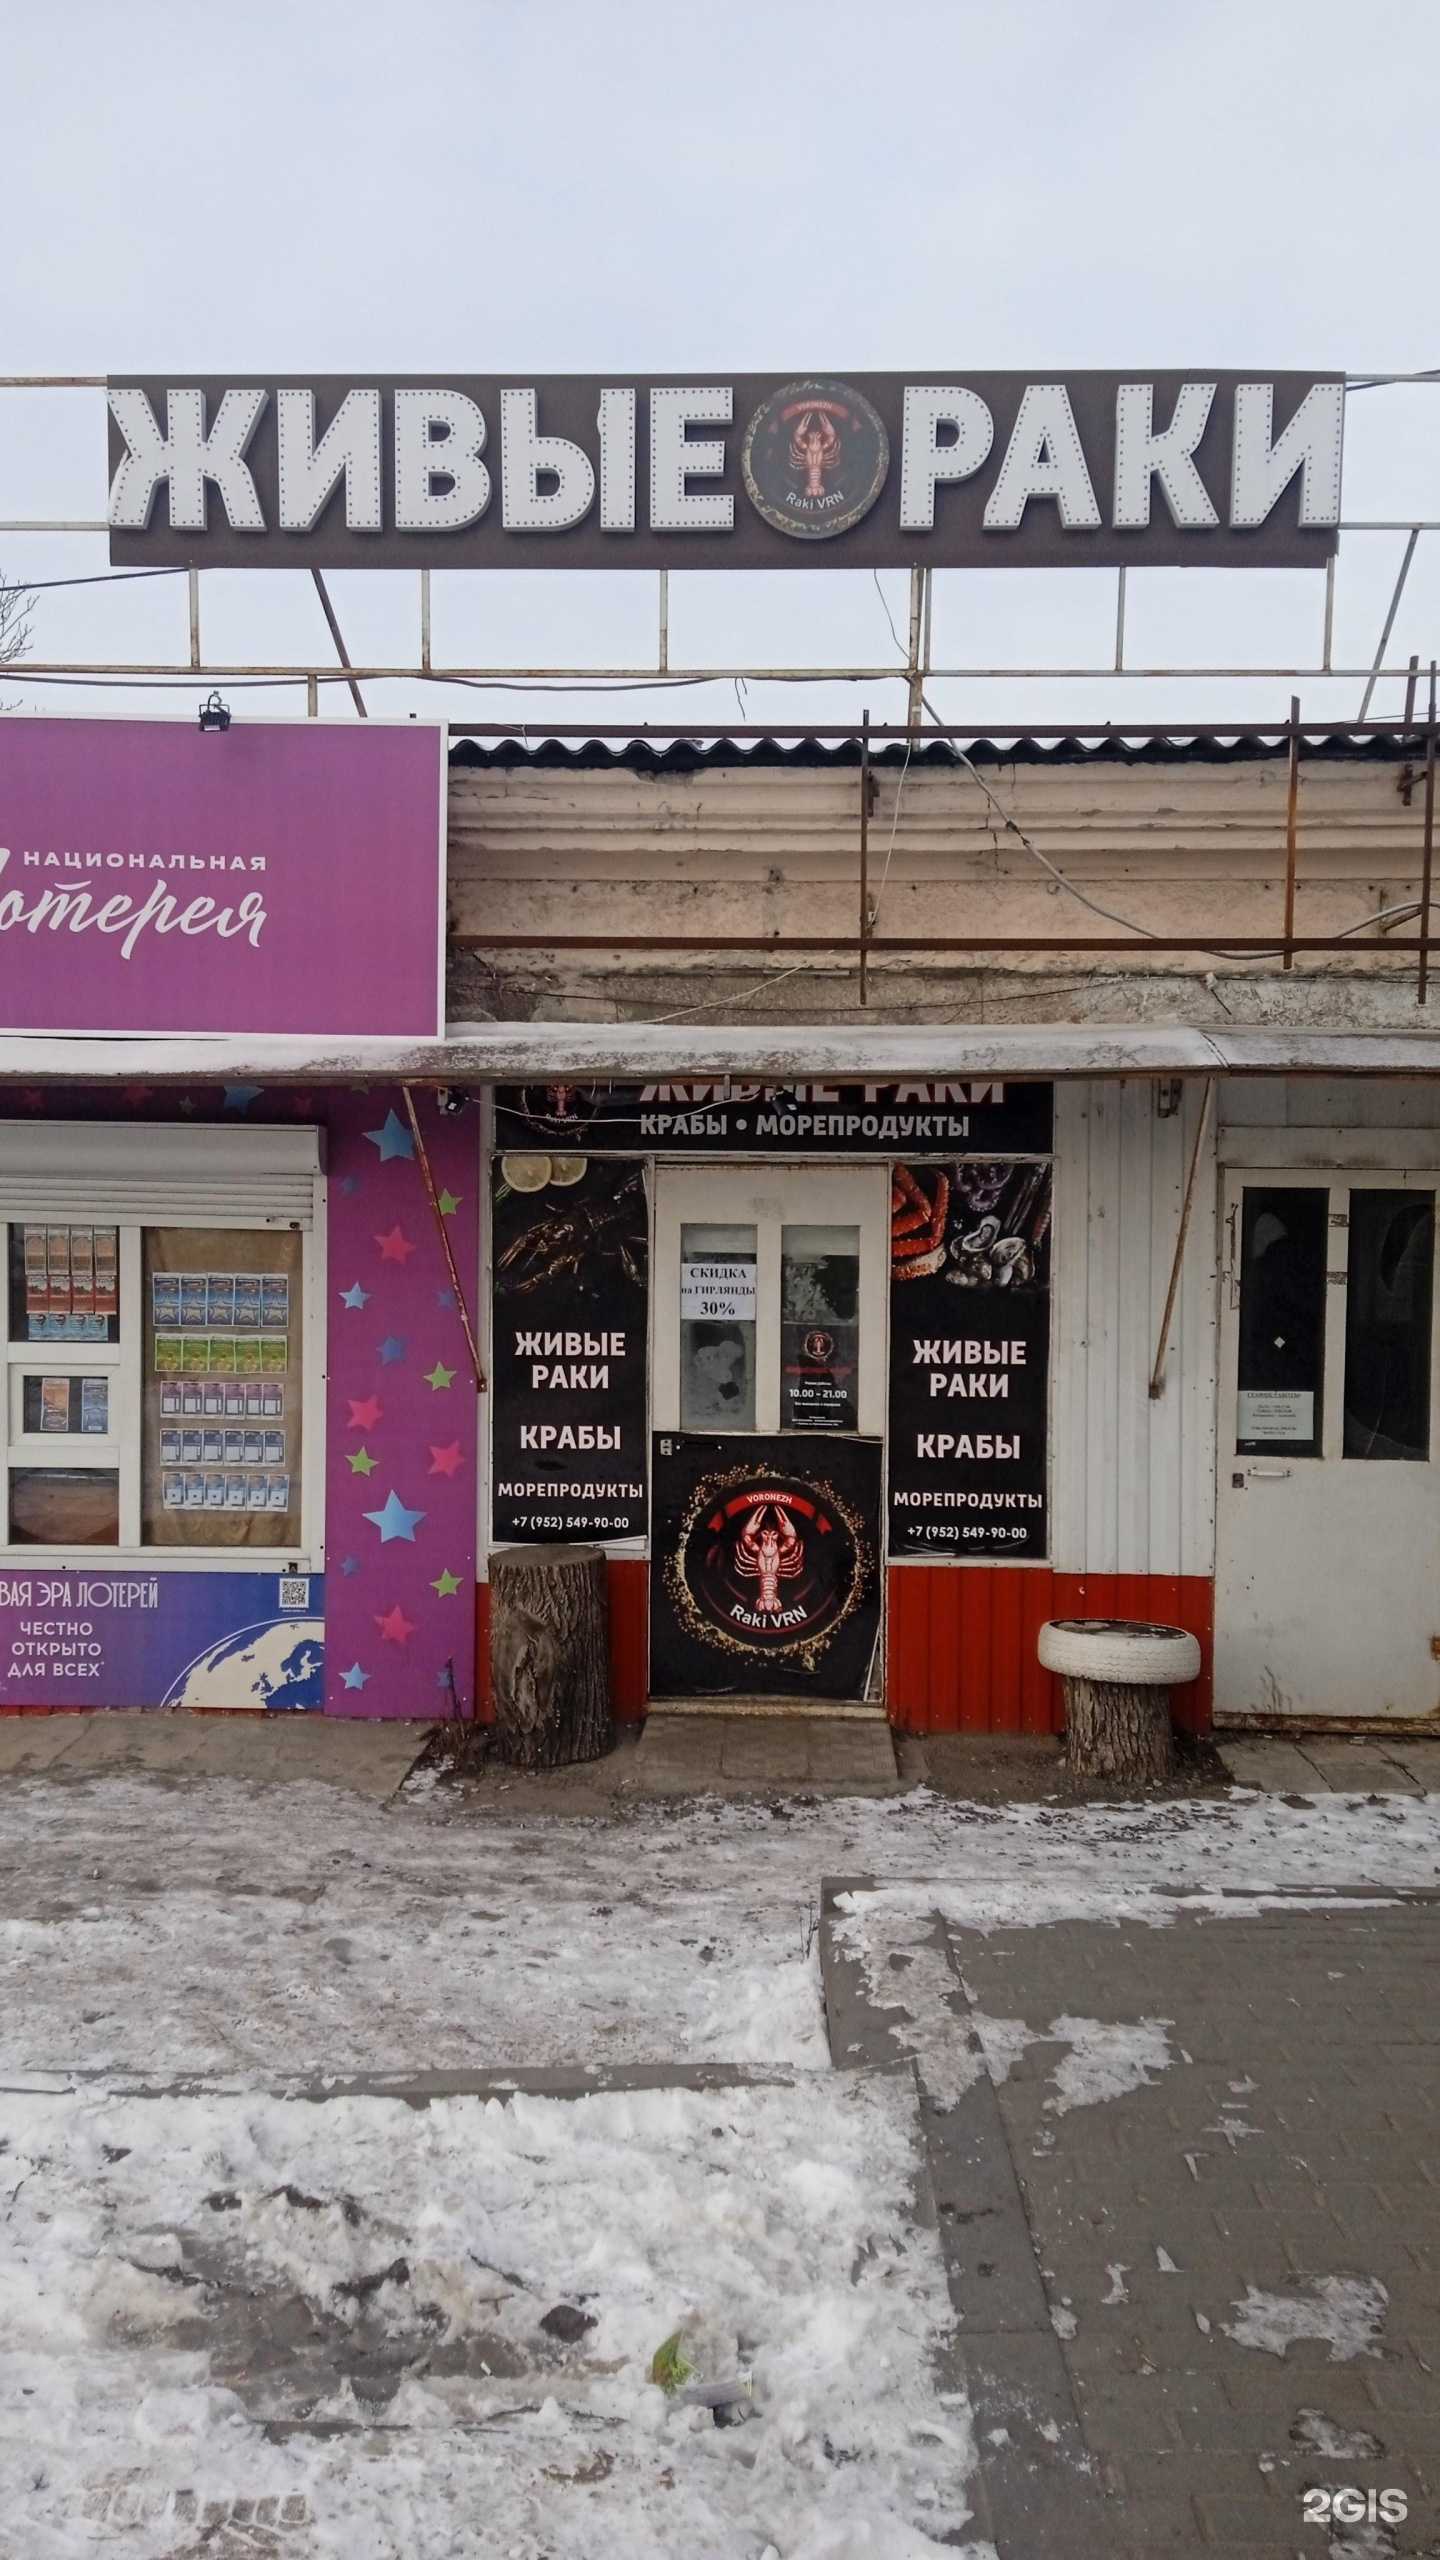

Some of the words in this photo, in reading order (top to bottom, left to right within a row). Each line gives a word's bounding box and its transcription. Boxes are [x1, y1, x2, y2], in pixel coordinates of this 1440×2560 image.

[105, 387, 735, 532] ЖИВЫЕ
[899, 382, 1344, 530] РАКИ
[785, 491, 814, 510] Raki
[816, 490, 845, 509] VRN
[23, 851, 267, 871] НАЦИОНАЛЬНАЯ
[640, 1114, 727, 1135] КРАБЫ
[755, 1114, 969, 1140] МОРЕПРОДУКТЫ
[690, 1267, 747, 1280] СКИДКА
[695, 1286, 756, 1296] ГИРЛЯНДЫ
[700, 1301, 736, 1315] 30%
[514, 1332, 626, 1356] ЖИВЫЕ
[912, 1340, 1027, 1365] ЖИВЫЕ
[532, 1365, 609, 1389] РАКИ
[930, 1373, 1009, 1397] РАКИ
[520, 1425, 621, 1450] КРАБЫ
[917, 1434, 1021, 1459] КРАБЫ
[497, 1483, 643, 1499] МОРЕПРОДУКТЫ
[746, 1493, 793, 1504] VORONEZH
[893, 1492, 1043, 1509] МОРЕПРОДУКТЫ
[512, 1517, 528, 1528] +7
[530, 1517, 563, 1530] (952)
[566, 1517, 629, 1529] 549-90-00
[907, 1526, 923, 1537] +7
[925, 1527, 959, 1540] (952)
[962, 1527, 1027, 1539] 549-90-00
[36, 1582, 72, 1608] ЭРА
[76, 1577, 158, 1608] ЛОТЕРЕЙ
[730, 1604, 767, 1628] Raki
[771, 1606, 807, 1628] VRN
[20, 1622, 93, 1636] ЧЕСТНО
[11, 1642, 102, 1656] ОТКРЫТО
[8, 1662, 46, 1678] ДЛЯ
